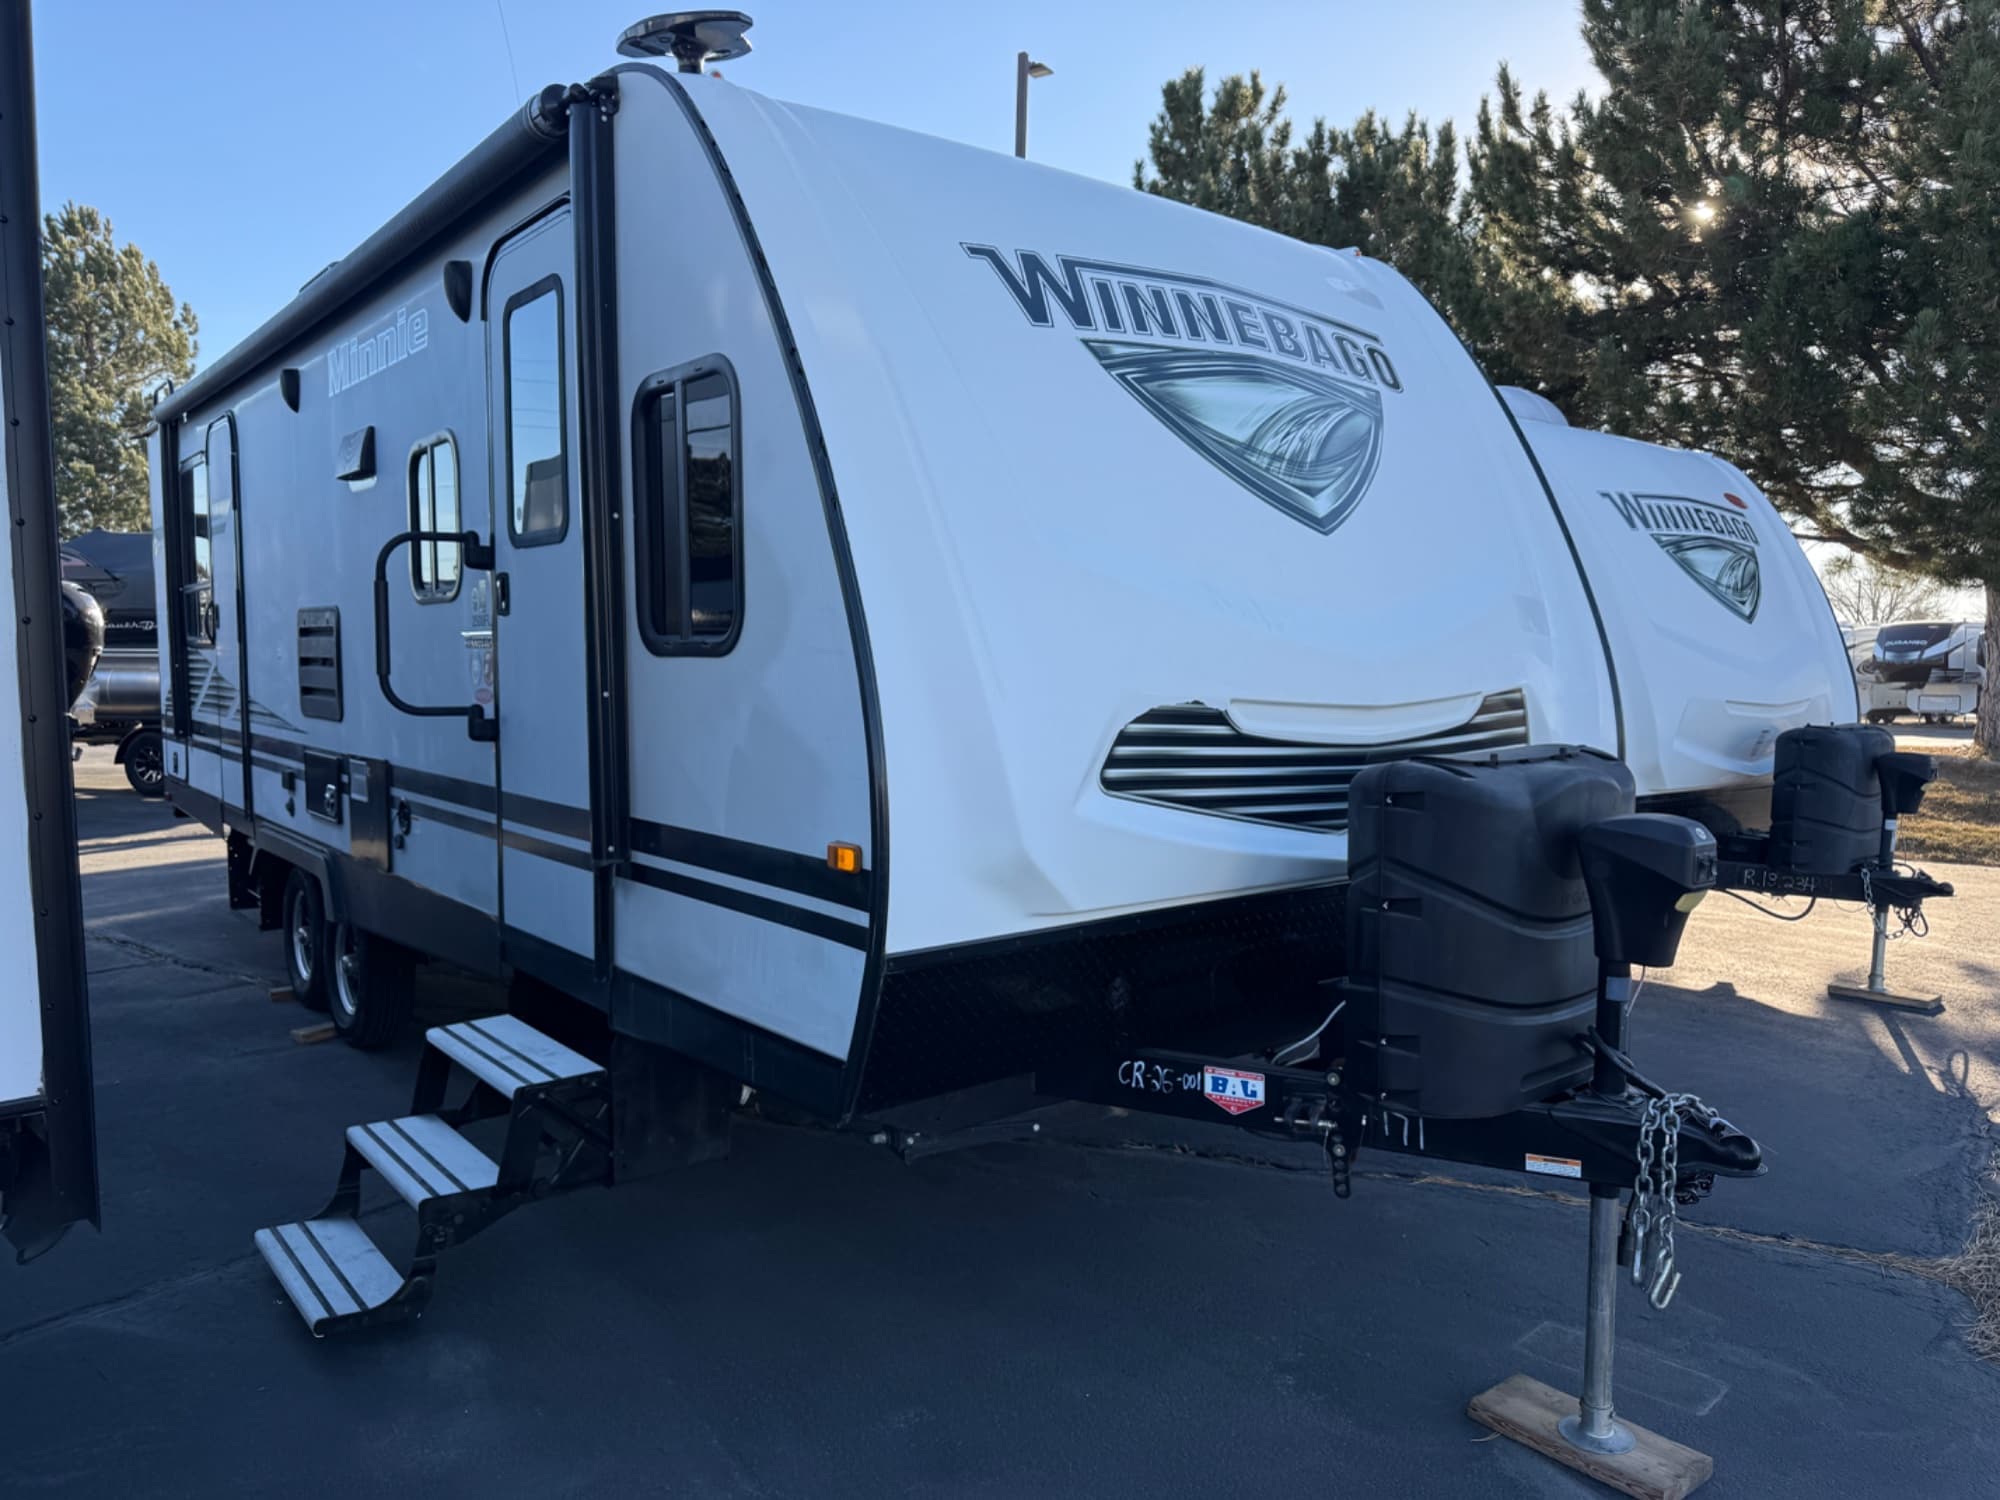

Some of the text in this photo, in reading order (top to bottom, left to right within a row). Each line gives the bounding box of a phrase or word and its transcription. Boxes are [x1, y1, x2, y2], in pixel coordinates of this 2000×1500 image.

[327, 307, 428, 398] Minnie
[959, 242, 1403, 393] WINNEBAGO
[1597, 490, 1760, 546] WINNEBAGO
